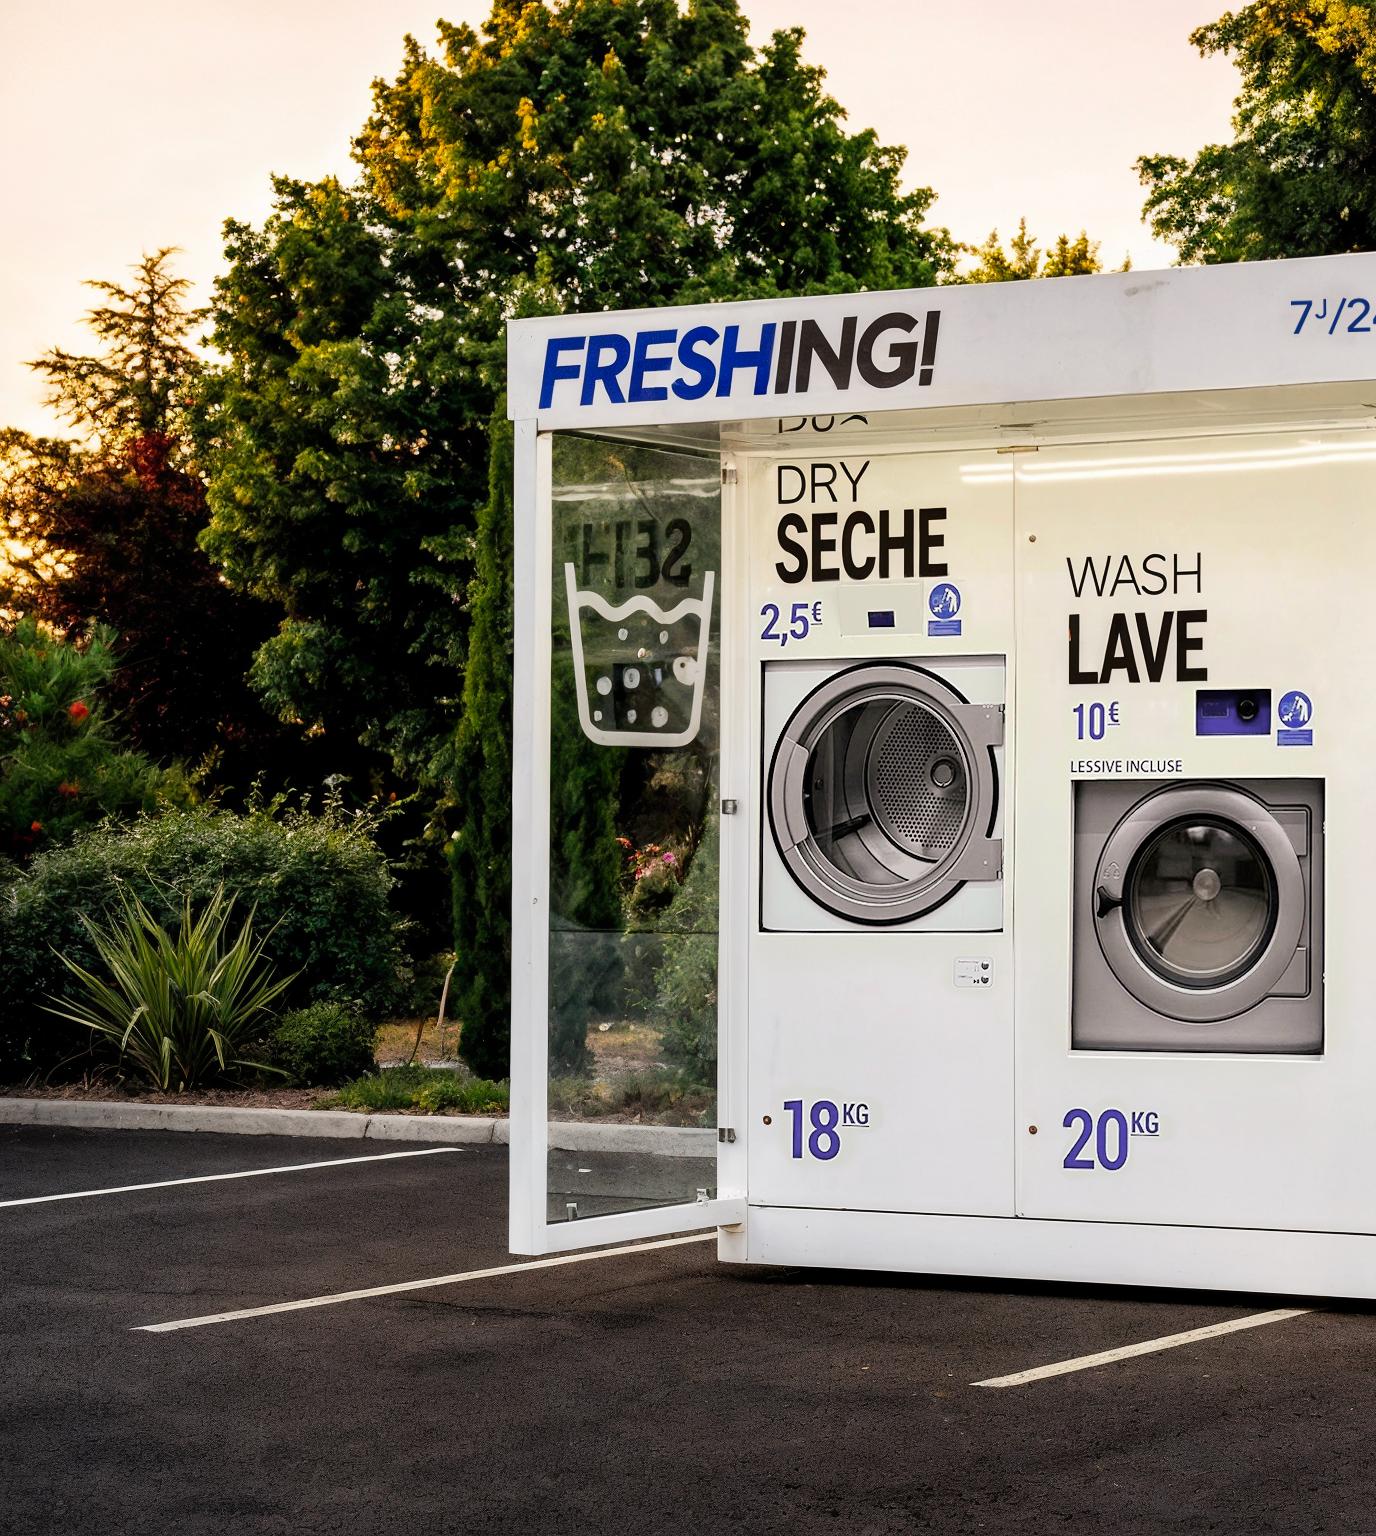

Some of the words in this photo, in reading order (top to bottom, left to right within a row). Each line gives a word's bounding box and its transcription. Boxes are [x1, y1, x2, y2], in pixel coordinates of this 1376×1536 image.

[538, 310, 941, 409] FRESHING!
[777, 460, 870, 504] DRY
[776, 507, 950, 584] SECHE
[1066, 552, 1202, 597] WASH
[760, 601, 823, 647] 2,5€
[1068, 609, 1208, 684] LAVE
[1072, 701, 1121, 740] 10€
[1070, 760, 1123, 773] LESSIVE
[1126, 759, 1183, 773] INCLUSE
